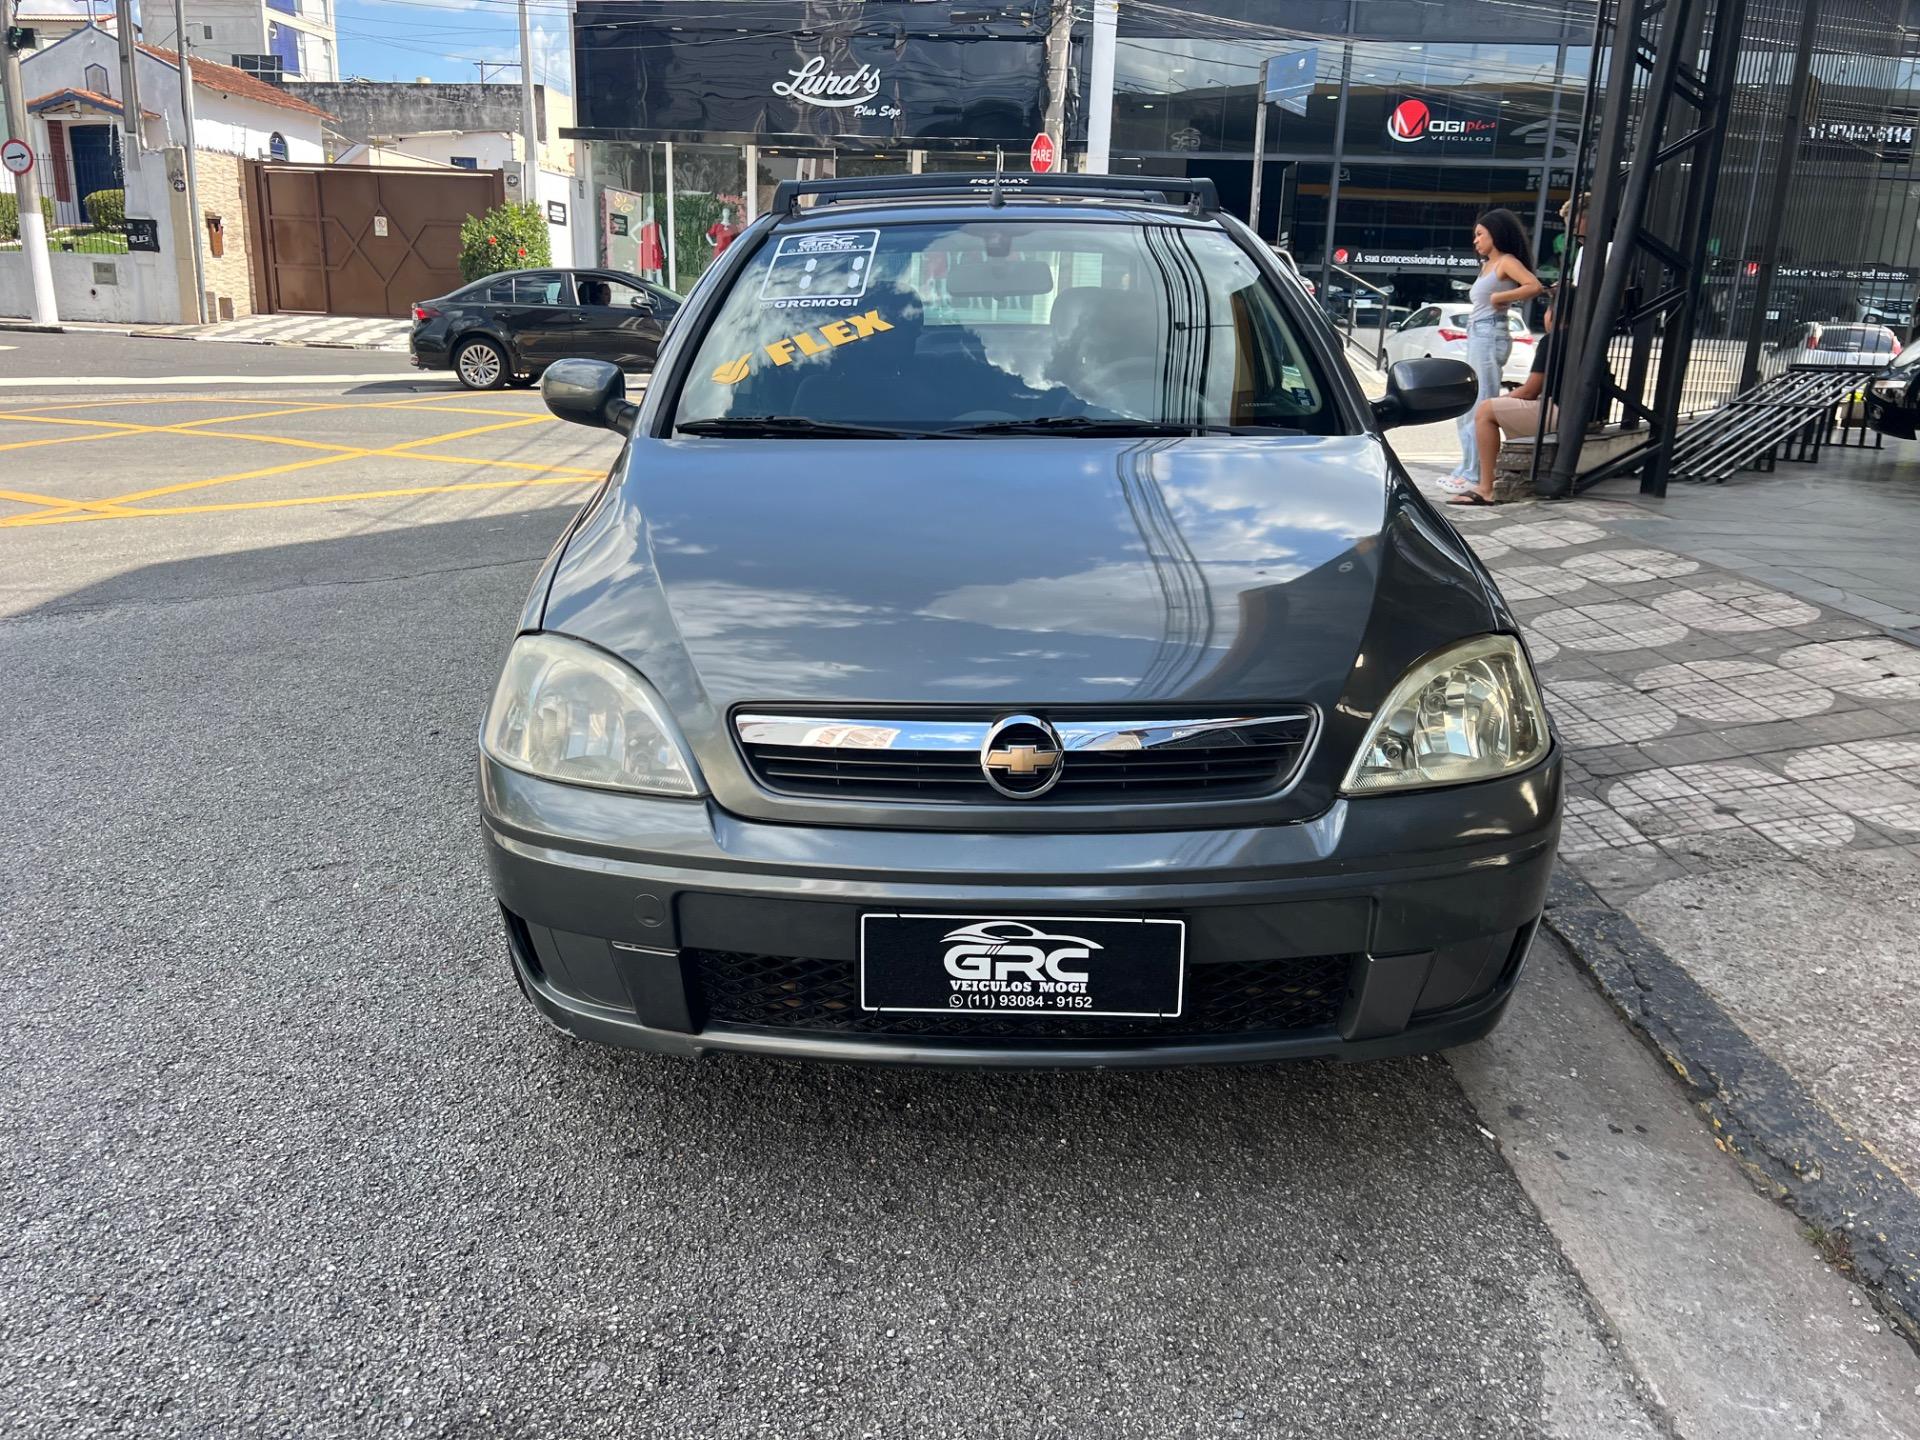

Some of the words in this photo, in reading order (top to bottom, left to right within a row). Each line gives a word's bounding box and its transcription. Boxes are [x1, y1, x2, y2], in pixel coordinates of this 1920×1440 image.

[772, 56, 880, 107] Lurd's
[854, 105, 876, 117] Plus
[1032, 149, 1052, 162] PARE
[1354, 252, 1363, 263] A
[1364, 255, 1379, 263] sua
[1447, 255, 1457, 265] de
[764, 309, 896, 367] FLEX
[943, 944, 1090, 983] GRC
[949, 980, 1032, 992] VEICULOS
[1039, 982, 1087, 993] MOGI
[967, 994, 996, 1008] (11)
[999, 994, 1044, 1007] 93084
[1056, 996, 1093, 1008] 9152
